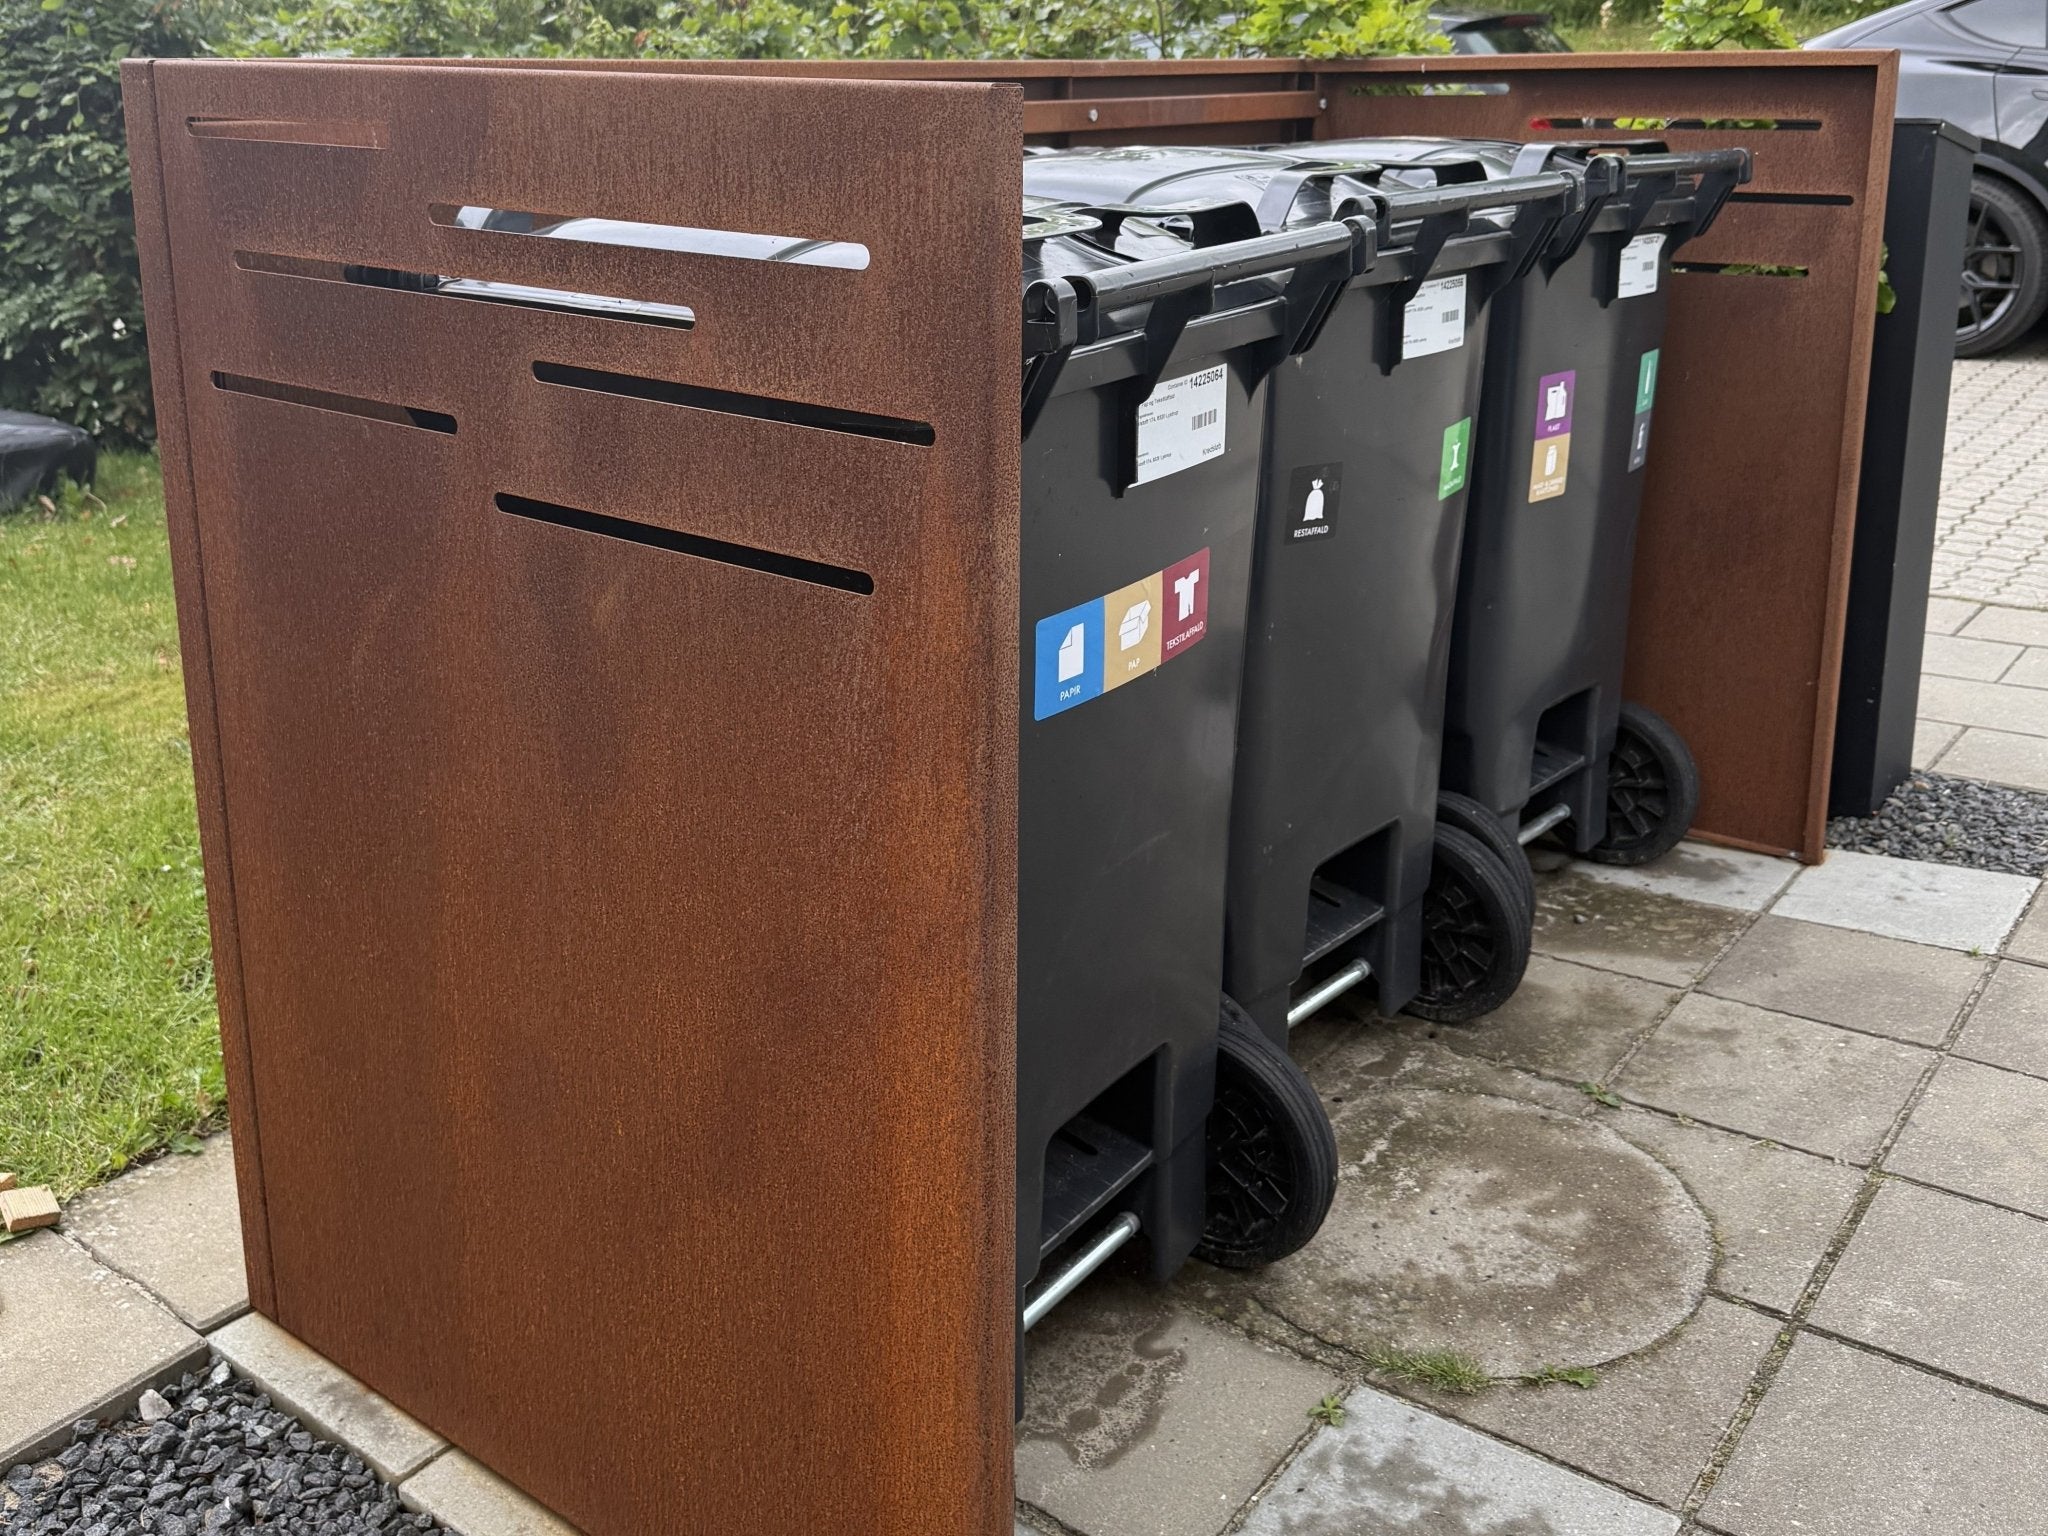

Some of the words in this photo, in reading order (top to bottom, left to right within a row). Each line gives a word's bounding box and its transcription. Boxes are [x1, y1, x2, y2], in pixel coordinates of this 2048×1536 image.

[1190, 368, 1223, 389] 14225064
[1294, 525, 1329, 538] RESTAFFALD
[1166, 621, 1204, 651] TEKSTILAFFALD
[1128, 657, 1141, 671] PAP
[1060, 685, 1081, 702] PAPIR
